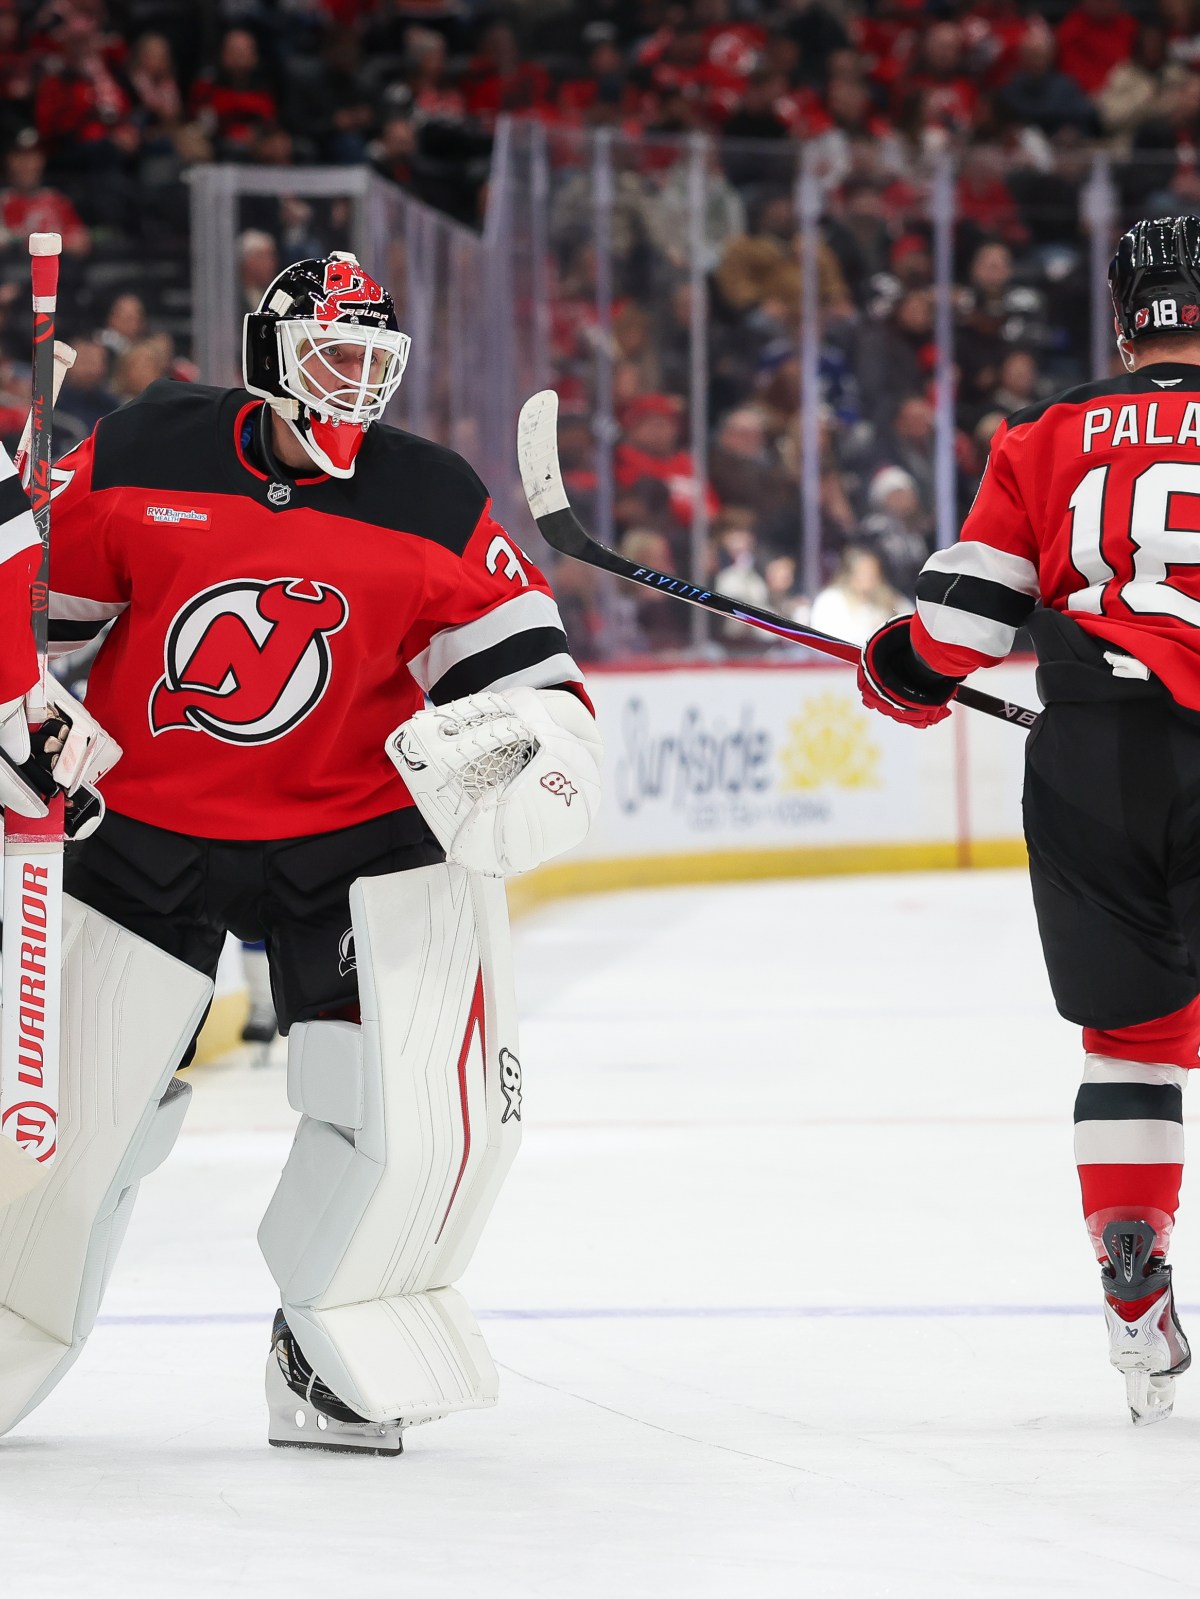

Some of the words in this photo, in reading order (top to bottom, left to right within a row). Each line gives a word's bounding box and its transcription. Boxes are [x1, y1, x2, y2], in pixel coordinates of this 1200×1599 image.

[345, 308, 389, 321] BAUER
[1152, 299, 1177, 328] 18
[147, 507, 208, 521] RWJBarnabas
[485, 534, 535, 588] 3
[631, 567, 712, 603] FLYLITE
[18, 862, 49, 1089] WARRIOR
